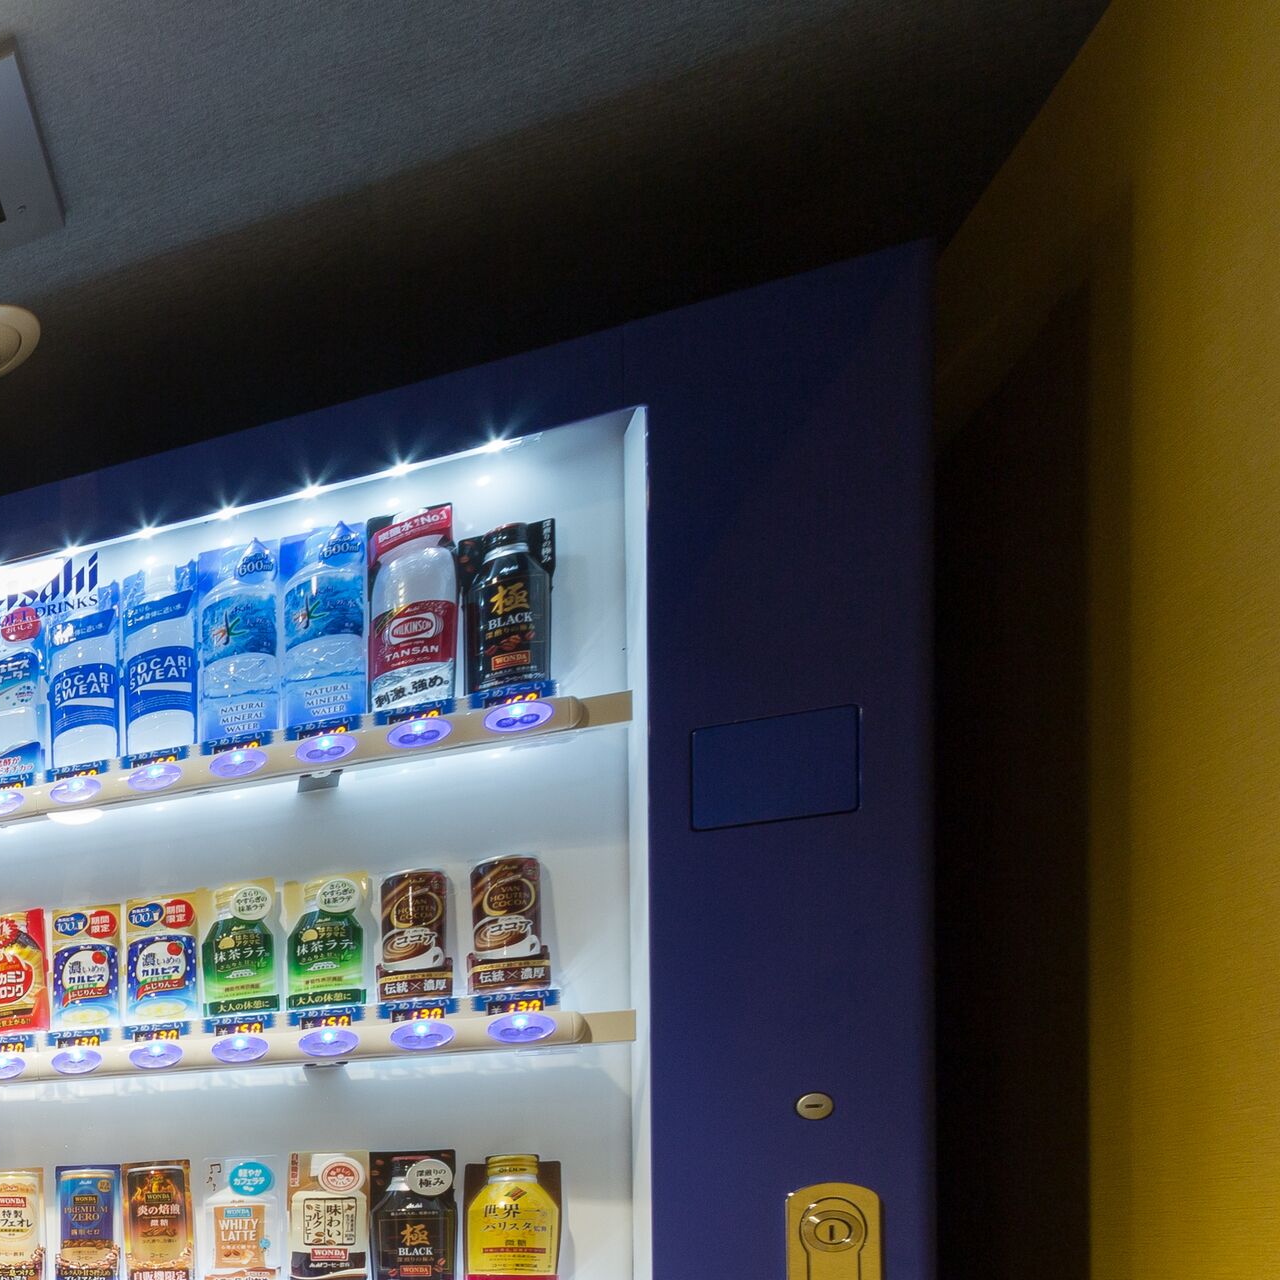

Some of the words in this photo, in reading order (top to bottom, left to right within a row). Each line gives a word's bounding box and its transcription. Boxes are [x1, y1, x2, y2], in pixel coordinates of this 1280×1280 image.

[490, 582, 529, 615] 極
[35, 593, 98, 617] DRINKS
[488, 611, 533, 631] BLACK
[392, 617, 434, 638] WILKINSON
[385, 645, 440, 662] TANSAN
[494, 654, 528, 665] WONDA
[129, 656, 191, 678] POCARI
[54, 671, 114, 694] POCARI
[129, 667, 188, 690] SWEAT
[54, 683, 110, 706] SWEAT
[304, 684, 351, 697] NATURAL
[375, 675, 450, 708] 刺激、強め。
[306, 694, 350, 707] MINERAL
[220, 701, 265, 714] NATURAL
[311, 704, 346, 716] WATER
[221, 712, 264, 724] MINERAL
[226, 722, 259, 733] WATER
[166, 904, 186, 914] 期間
[91, 915, 110, 924] 期間
[166, 915, 186, 924] 限定
[91, 925, 110, 933] 限定
[491, 920, 532, 933] ココア
[395, 933, 437, 946] ココア
[297, 939, 353, 956] 抹茶ラテ
[142, 953, 181, 967] 濃いめの
[214, 947, 266, 964] 抹茶ラテ
[68, 961, 106, 975] 濃いめの
[142, 966, 180, 977] カルピス
[68, 975, 105, 985] カルピス
[144, 981, 179, 991] ふじりんご
[298, 994, 351, 1006] 大人の休憩に
[218, 1001, 270, 1012] 大人の休憩に
[416, 1169, 446, 1177] 深煎りの
[233, 1177, 265, 1186] カフェラテ
[418, 1177, 445, 1188] 極み
[147, 1193, 170, 1201] WONDA
[2, 1210, 22, 1218] 特製
[64, 1206, 108, 1214] PREMIUM
[137, 1205, 181, 1217] 炎の焙煎
[71, 1213, 100, 1222] ZERO
[151, 1219, 169, 1227] 微糖
[313, 1204, 322, 1230] ミルク
[326, 1204, 341, 1238] 味わい
[219, 1219, 259, 1231] WHITY
[222, 1231, 257, 1242] LATTE
[401, 1224, 431, 1246] 極
[504, 1239, 527, 1247] 微糖
[313, 1249, 345, 1259] WONDA
[398, 1247, 433, 1256] BLACK
[402, 1267, 429, 1275] WONDA
